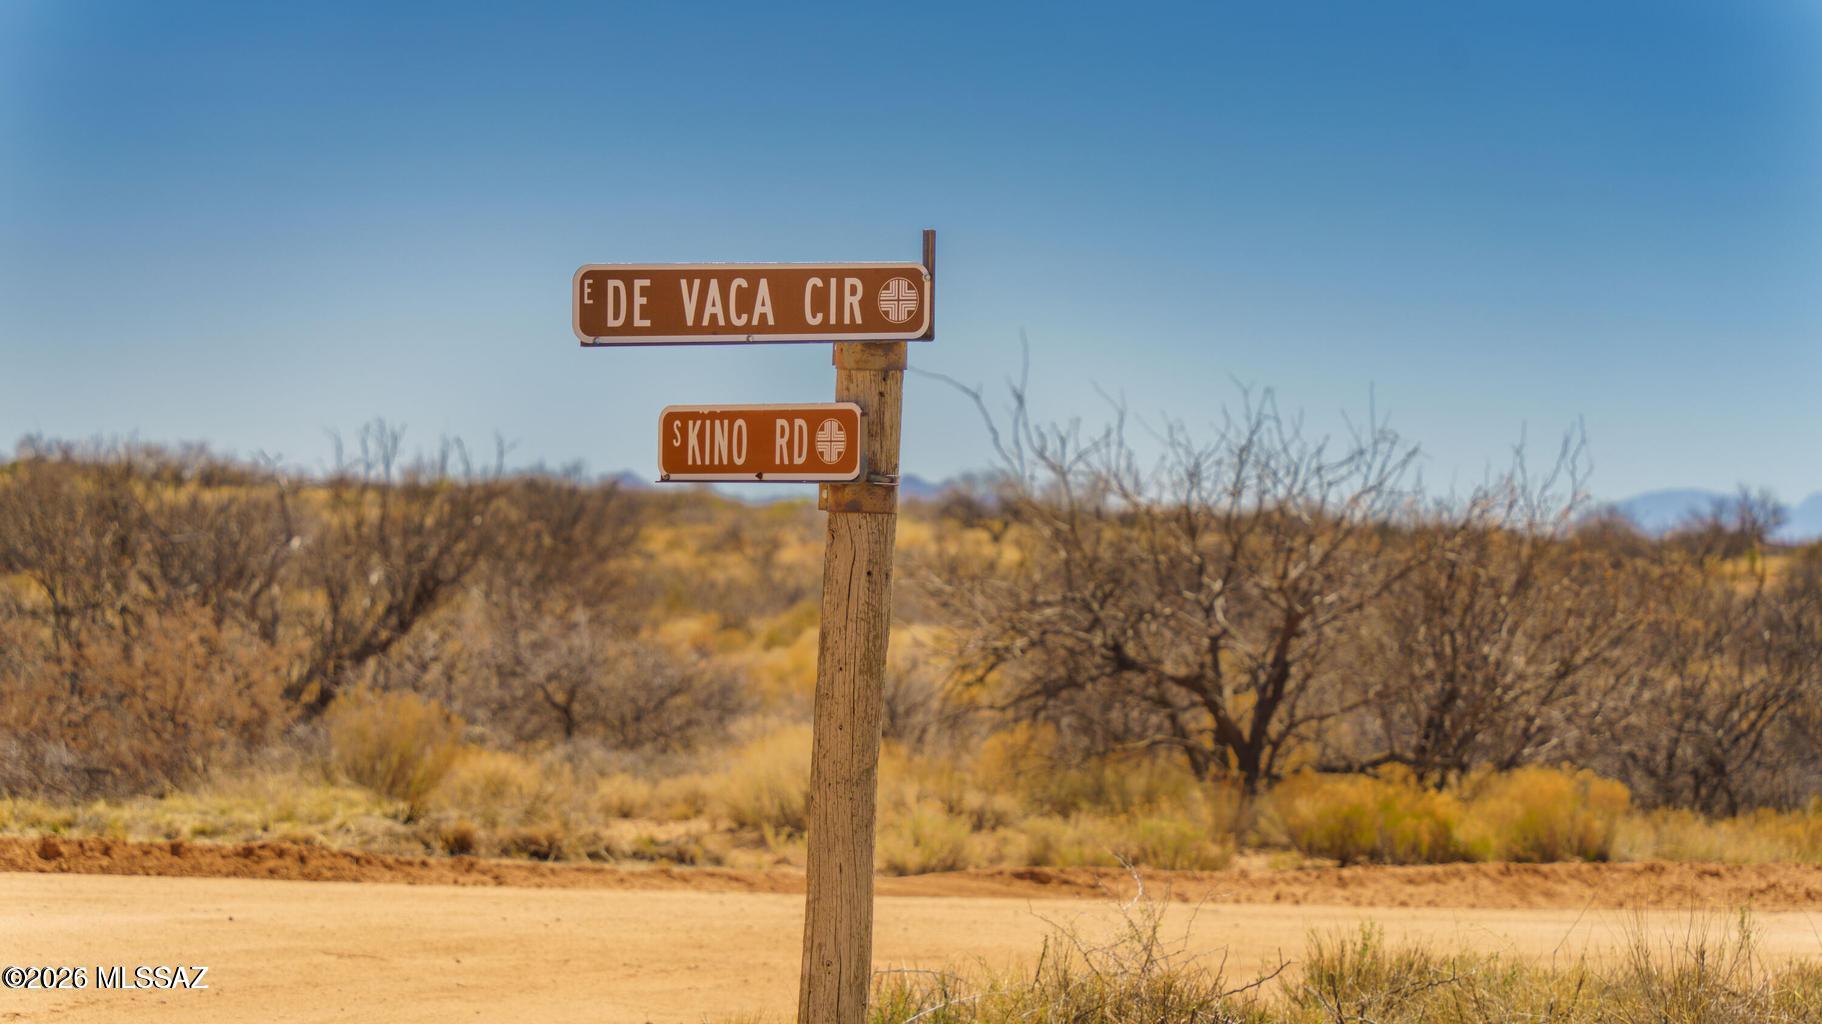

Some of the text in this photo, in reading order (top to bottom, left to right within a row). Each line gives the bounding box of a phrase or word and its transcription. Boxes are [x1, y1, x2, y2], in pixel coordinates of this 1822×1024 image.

[584, 276, 864, 327] E DE VACA CIR
[673, 418, 808, 466] S KINO RD
